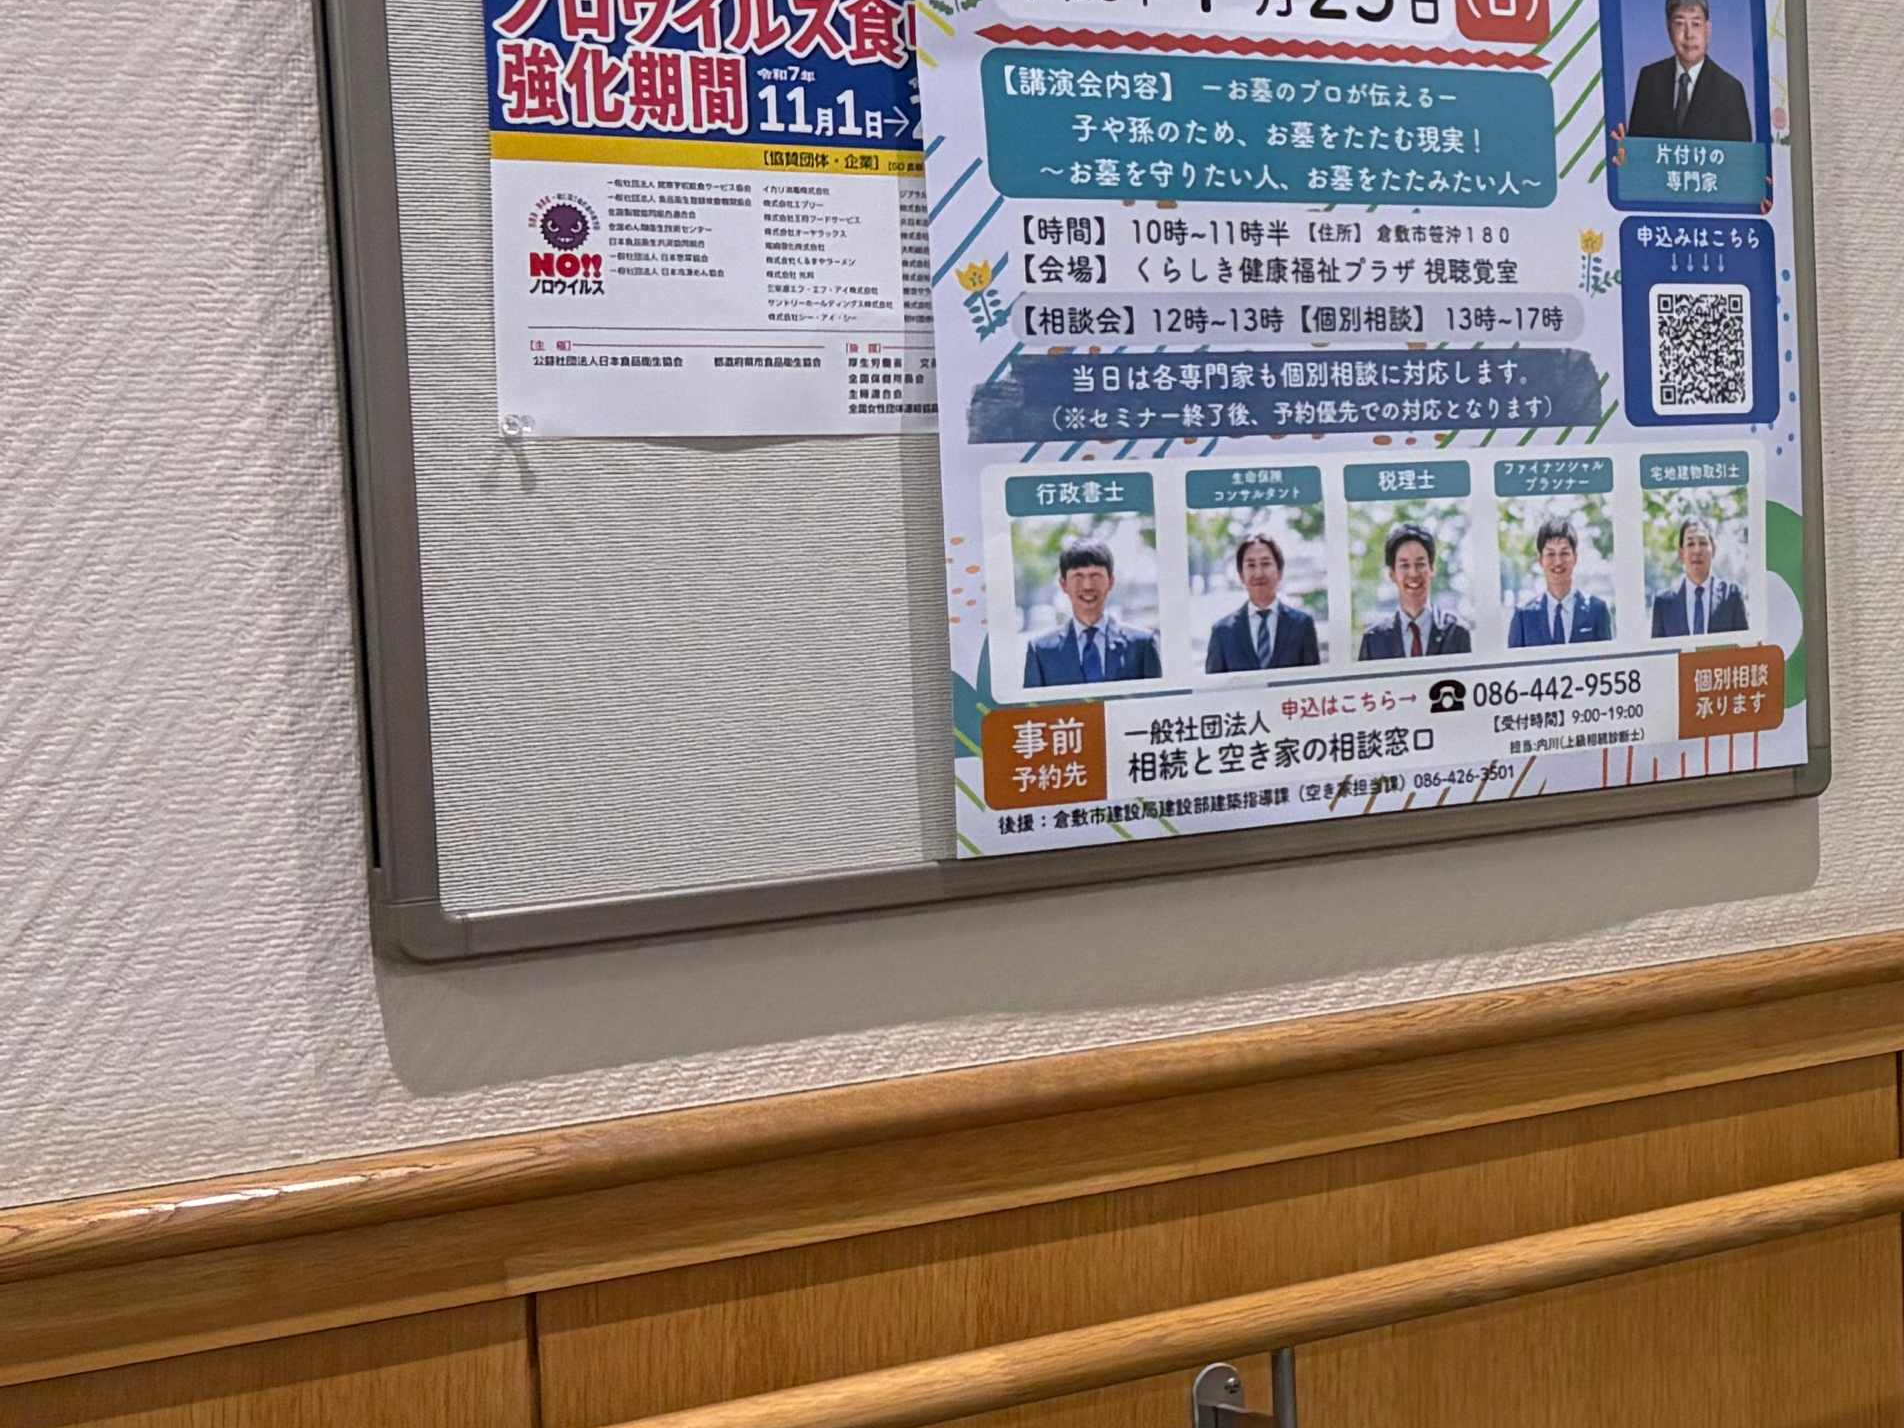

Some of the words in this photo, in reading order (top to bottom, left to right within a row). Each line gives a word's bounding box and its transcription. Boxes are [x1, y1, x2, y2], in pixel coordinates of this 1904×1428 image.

[498, 38, 748, 134] 強化期間
[757, 66, 816, 83] 令和7年
[1003, 64, 1174, 103] 【講演会内容】
[1656, 143, 1725, 166] 片付けの
[1666, 170, 1718, 193] 専門家
[1022, 215, 1110, 247] 【時間】
[1306, 224, 1363, 244] 【住所】
[1637, 225, 1760, 249] 申込みはこちら
[1022, 254, 1110, 285] 【会場】
[1136, 256, 1417, 286] くらしき健康福祉プラザ
[1424, 257, 1520, 286] 視聴覚室
[529, 279, 604, 295] ノロウイルス
[1022, 305, 1137, 336] 【相談会】
[1299, 304, 1426, 333] 【個別相談】
[1071, 358, 1530, 393] 当日は各専門家も個別相談に対応します。
[1378, 470, 1436, 492] 税理士
[1503, 461, 1605, 476] ファイナンシャル
[1650, 465, 1741, 482] 宅地建物取引士
[1036, 480, 1125, 506] 行政書士
[1213, 487, 1300, 503] コンサルタント
[1694, 662, 1769, 693] 個別相談
[1281, 693, 1398, 721] 申込はこちら
[1473, 669, 1642, 708] 086-442-9558
[1695, 689, 1766, 721] 承ります
[1124, 709, 1271, 746] 一般社団法人
[1494, 710, 1565, 733] 【受付時間】
[1012, 718, 1085, 761] 事前
[1128, 727, 1435, 784] 相続と空き家の相談窓口
[1012, 762, 1087, 793] 予約先
